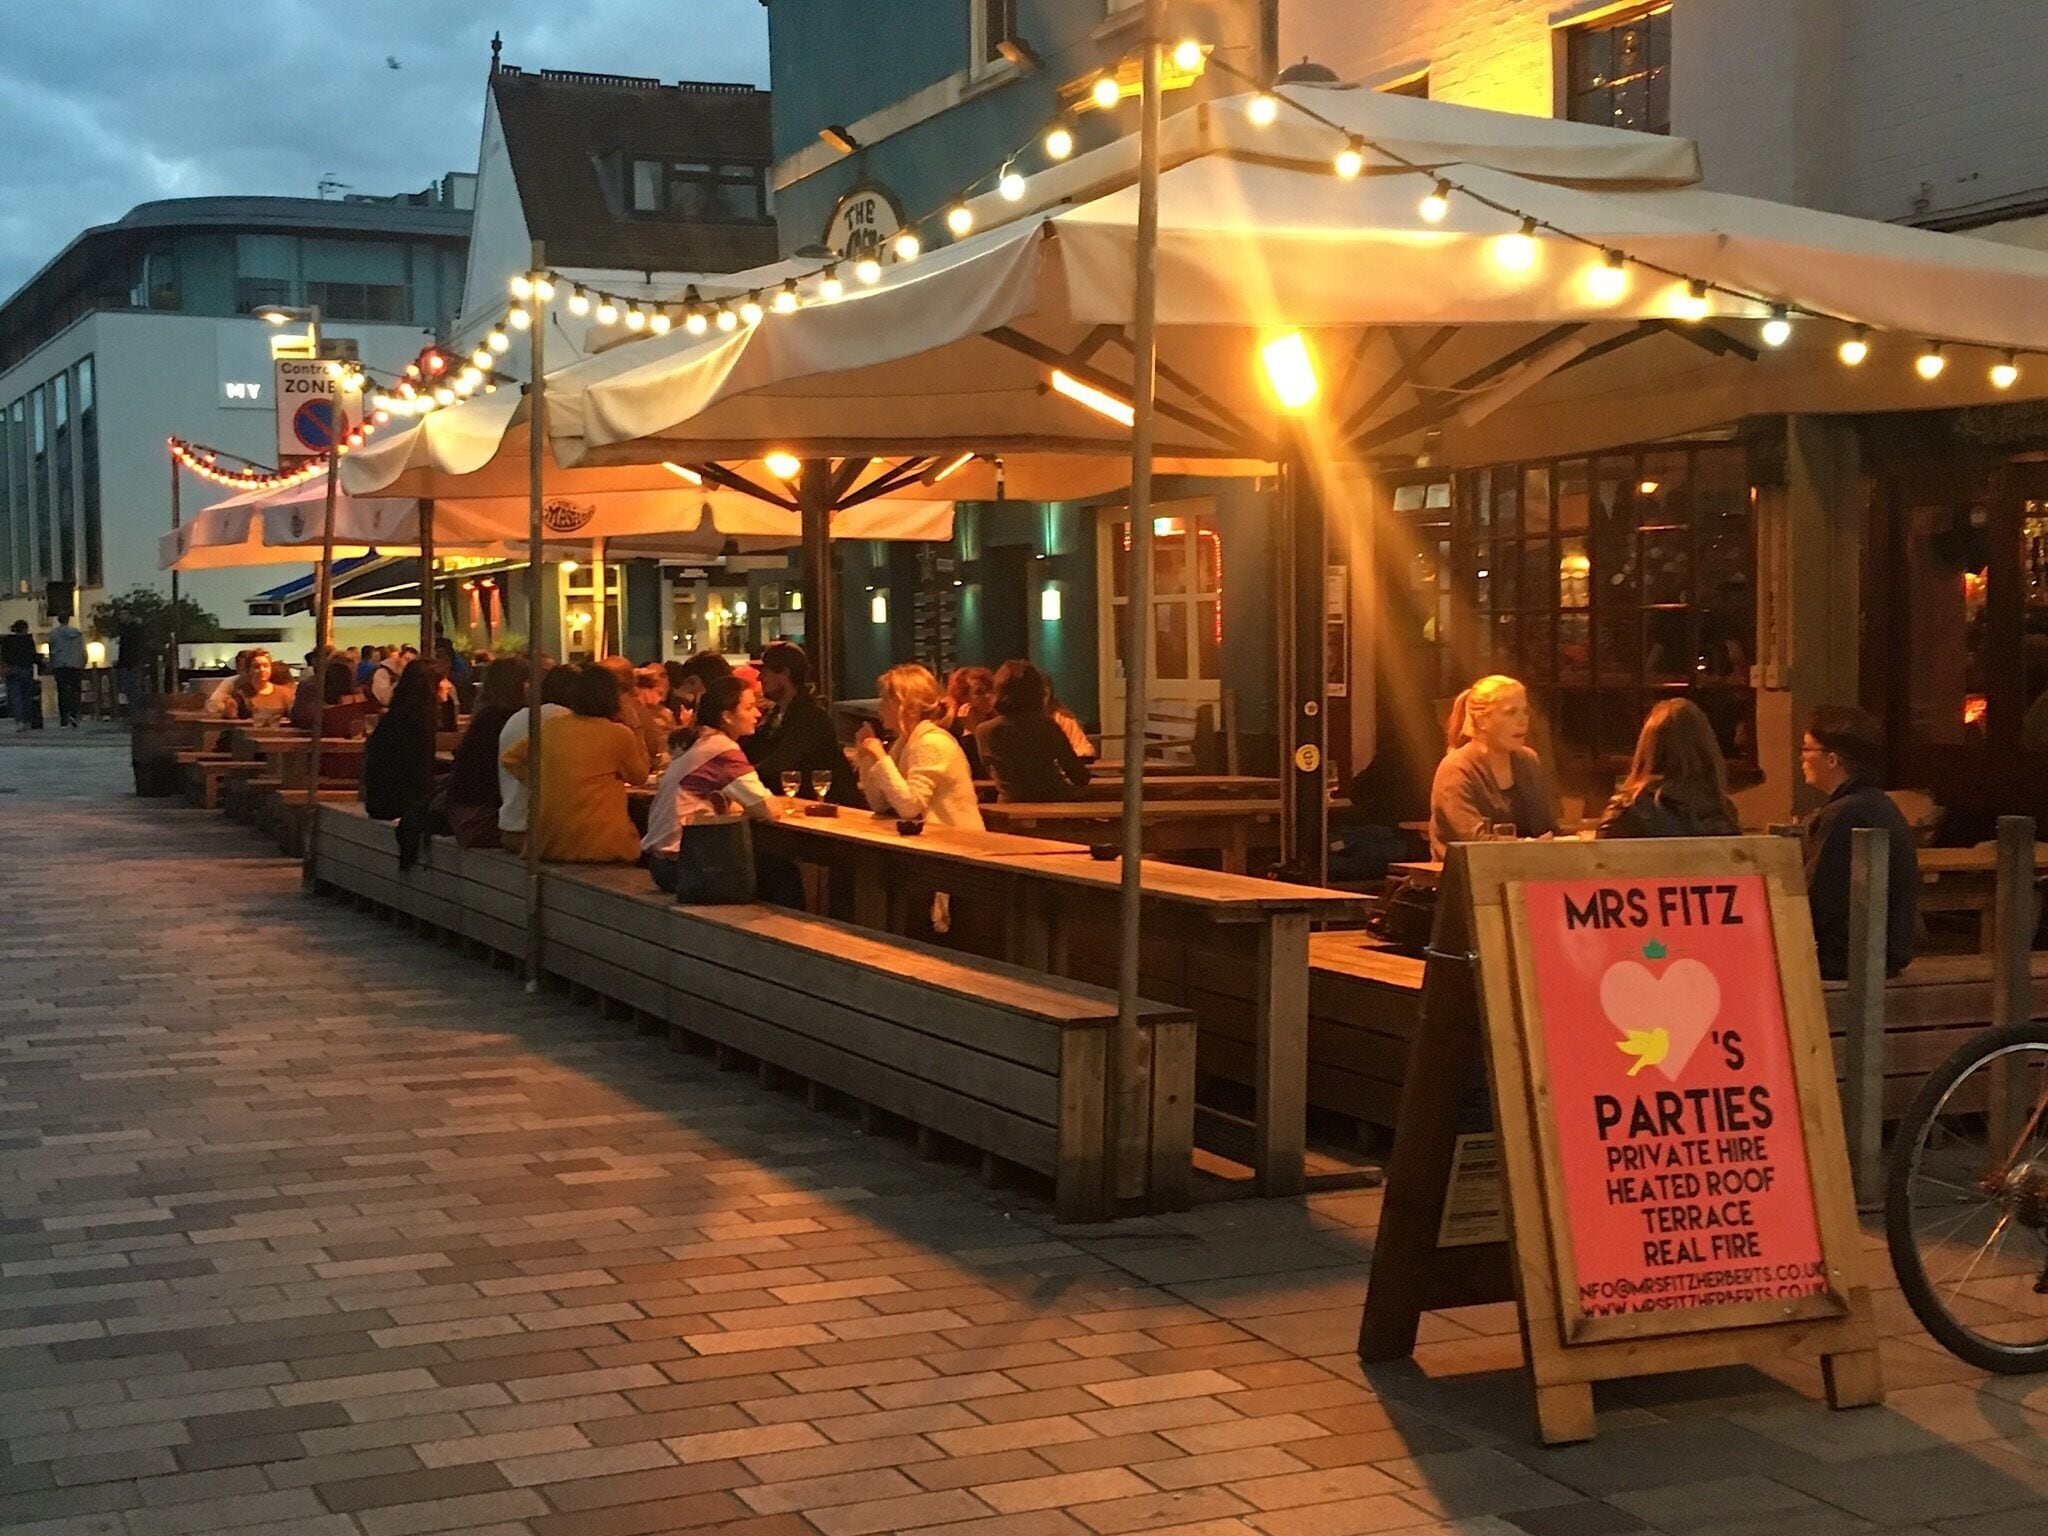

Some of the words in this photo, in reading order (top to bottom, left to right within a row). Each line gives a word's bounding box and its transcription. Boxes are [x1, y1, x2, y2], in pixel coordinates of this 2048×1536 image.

[844, 199, 875, 231] THE
[281, 362, 346, 375] Contro
[285, 379, 335, 393] ZONE
[226, 382, 261, 399] MY
[1564, 888, 1649, 930] MRS
[1658, 885, 1744, 926] FITZ
[1711, 1030, 1745, 1071] 'S
[1594, 1085, 1774, 1141] PARTIES
[1606, 1140, 1713, 1172] PRIVATE
[1717, 1136, 1768, 1164] HIRE
[1606, 1173, 1701, 1205] HEATED
[1706, 1166, 1775, 1196] ROOF
[1641, 1200, 1755, 1234] TERRACE
[1643, 1237, 1707, 1268] REAL
[1711, 1232, 1762, 1260] FIRE
[1580, 1261, 1825, 1301] NFO@MRSFITZHERBERTS.CO.UK
